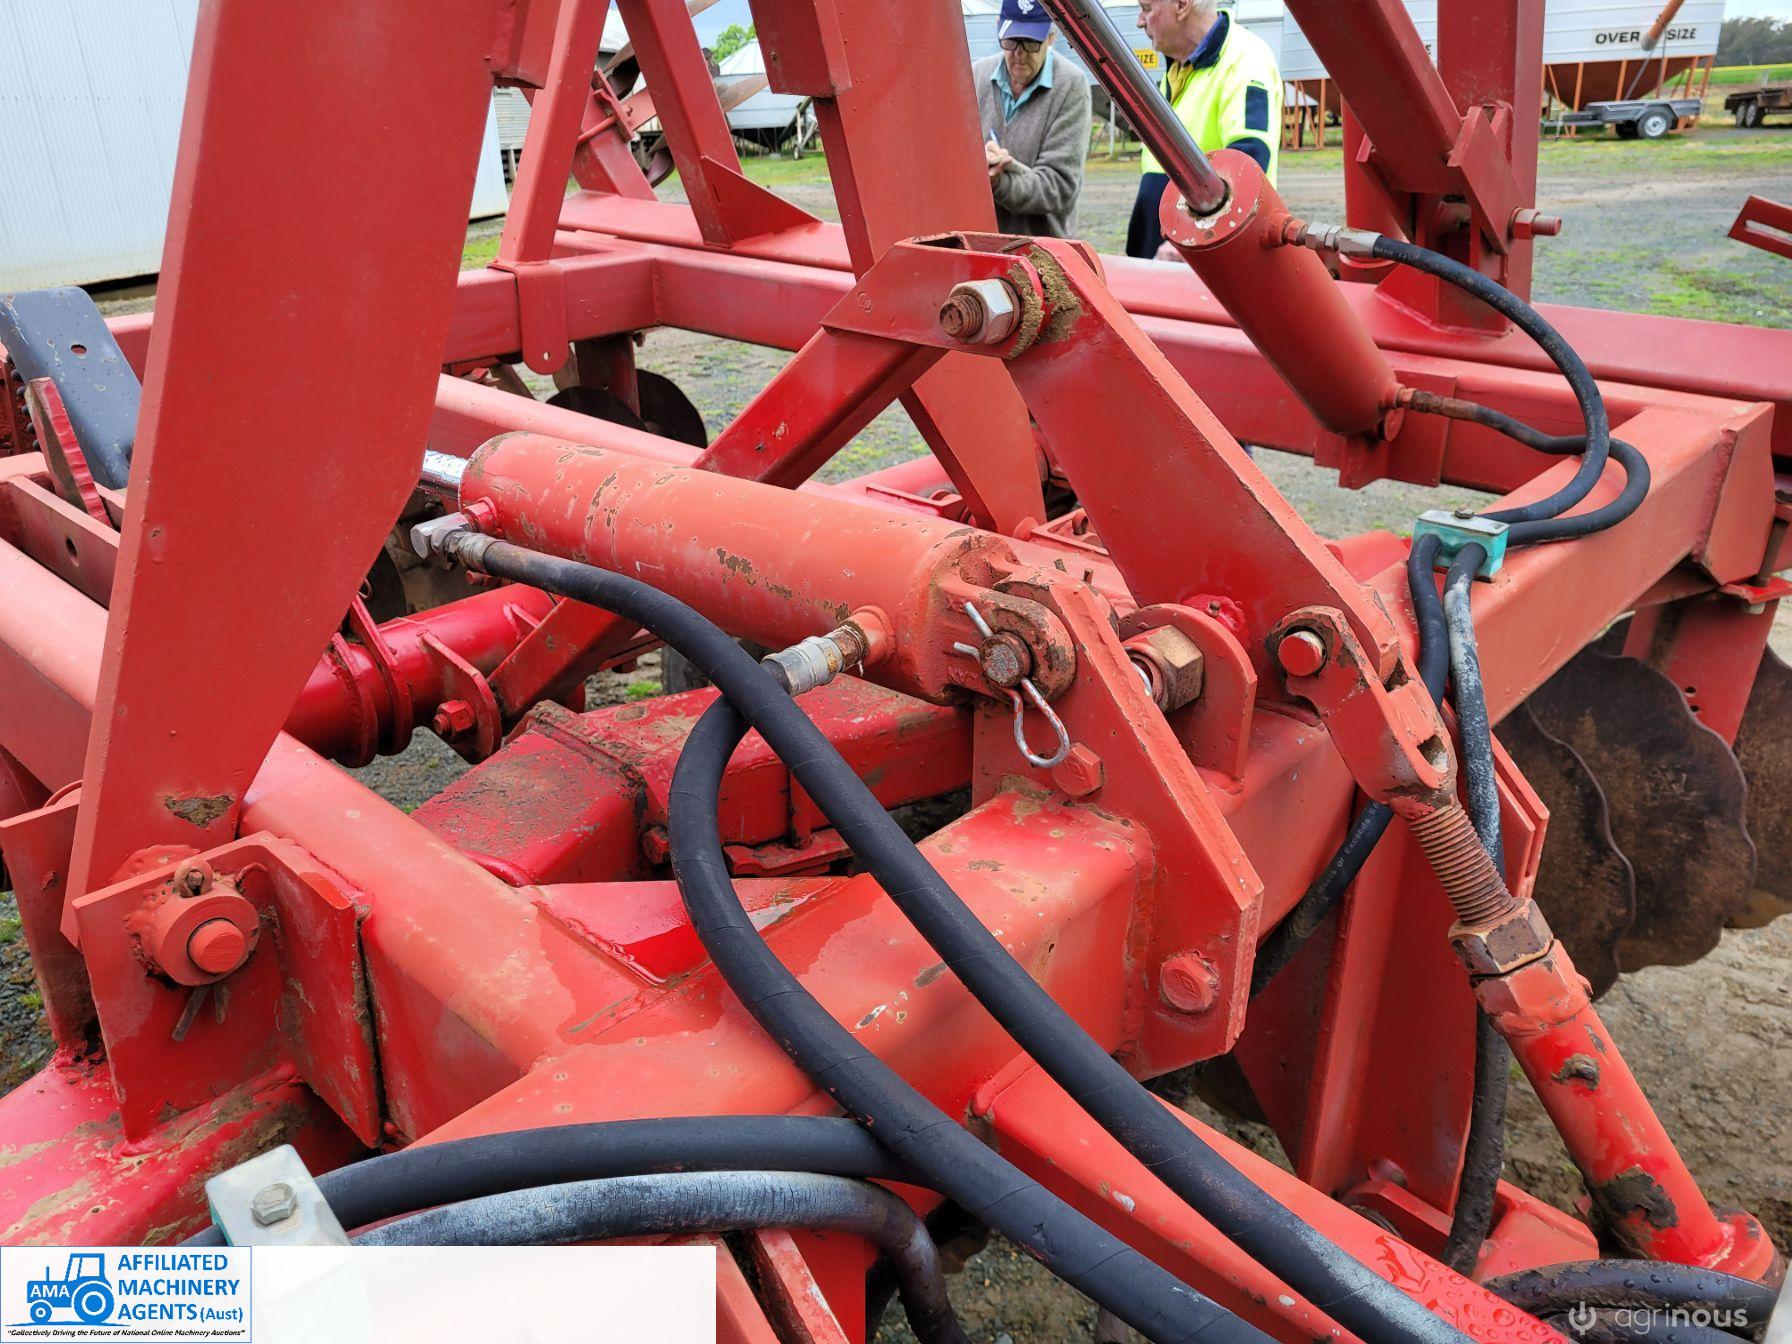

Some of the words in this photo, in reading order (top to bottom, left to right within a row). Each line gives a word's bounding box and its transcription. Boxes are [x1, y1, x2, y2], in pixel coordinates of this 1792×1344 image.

[1595, 31, 1640, 44] OVER
[1666, 28, 1697, 40] SIZE
[1137, 53, 1154, 64] IZE
